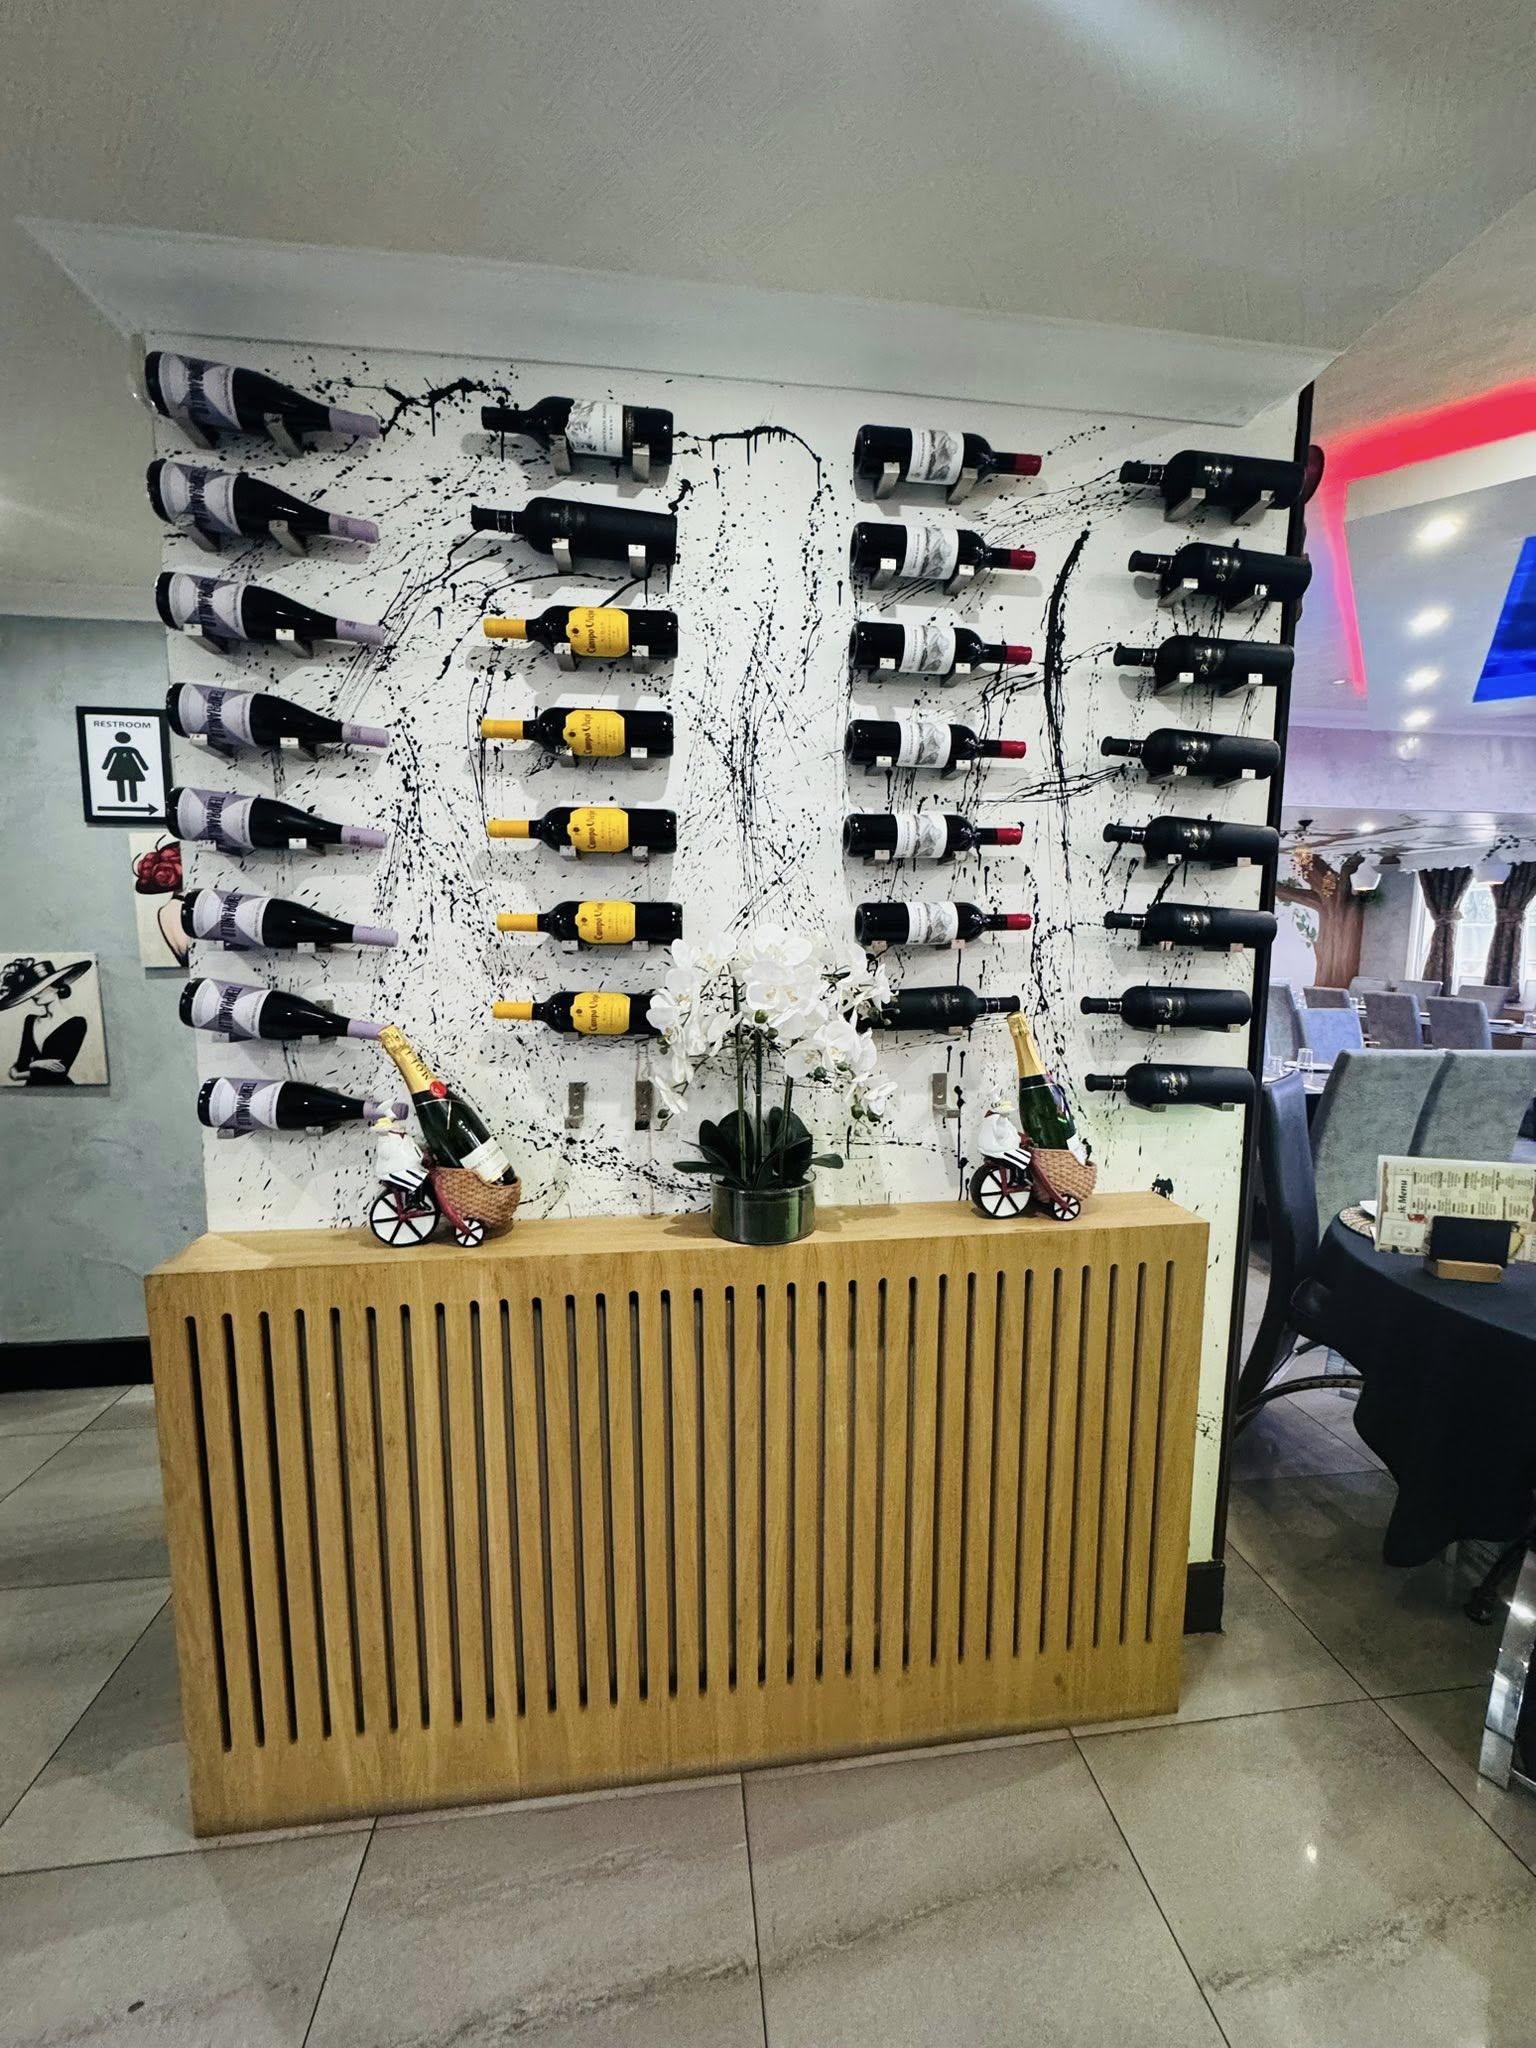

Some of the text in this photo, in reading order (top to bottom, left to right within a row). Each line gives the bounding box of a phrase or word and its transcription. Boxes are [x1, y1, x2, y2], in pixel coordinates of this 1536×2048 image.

[586, 629, 598, 653] Campo
[93, 720, 151, 729] RESTROOM
[1398, 1180, 1408, 1204] Menu
